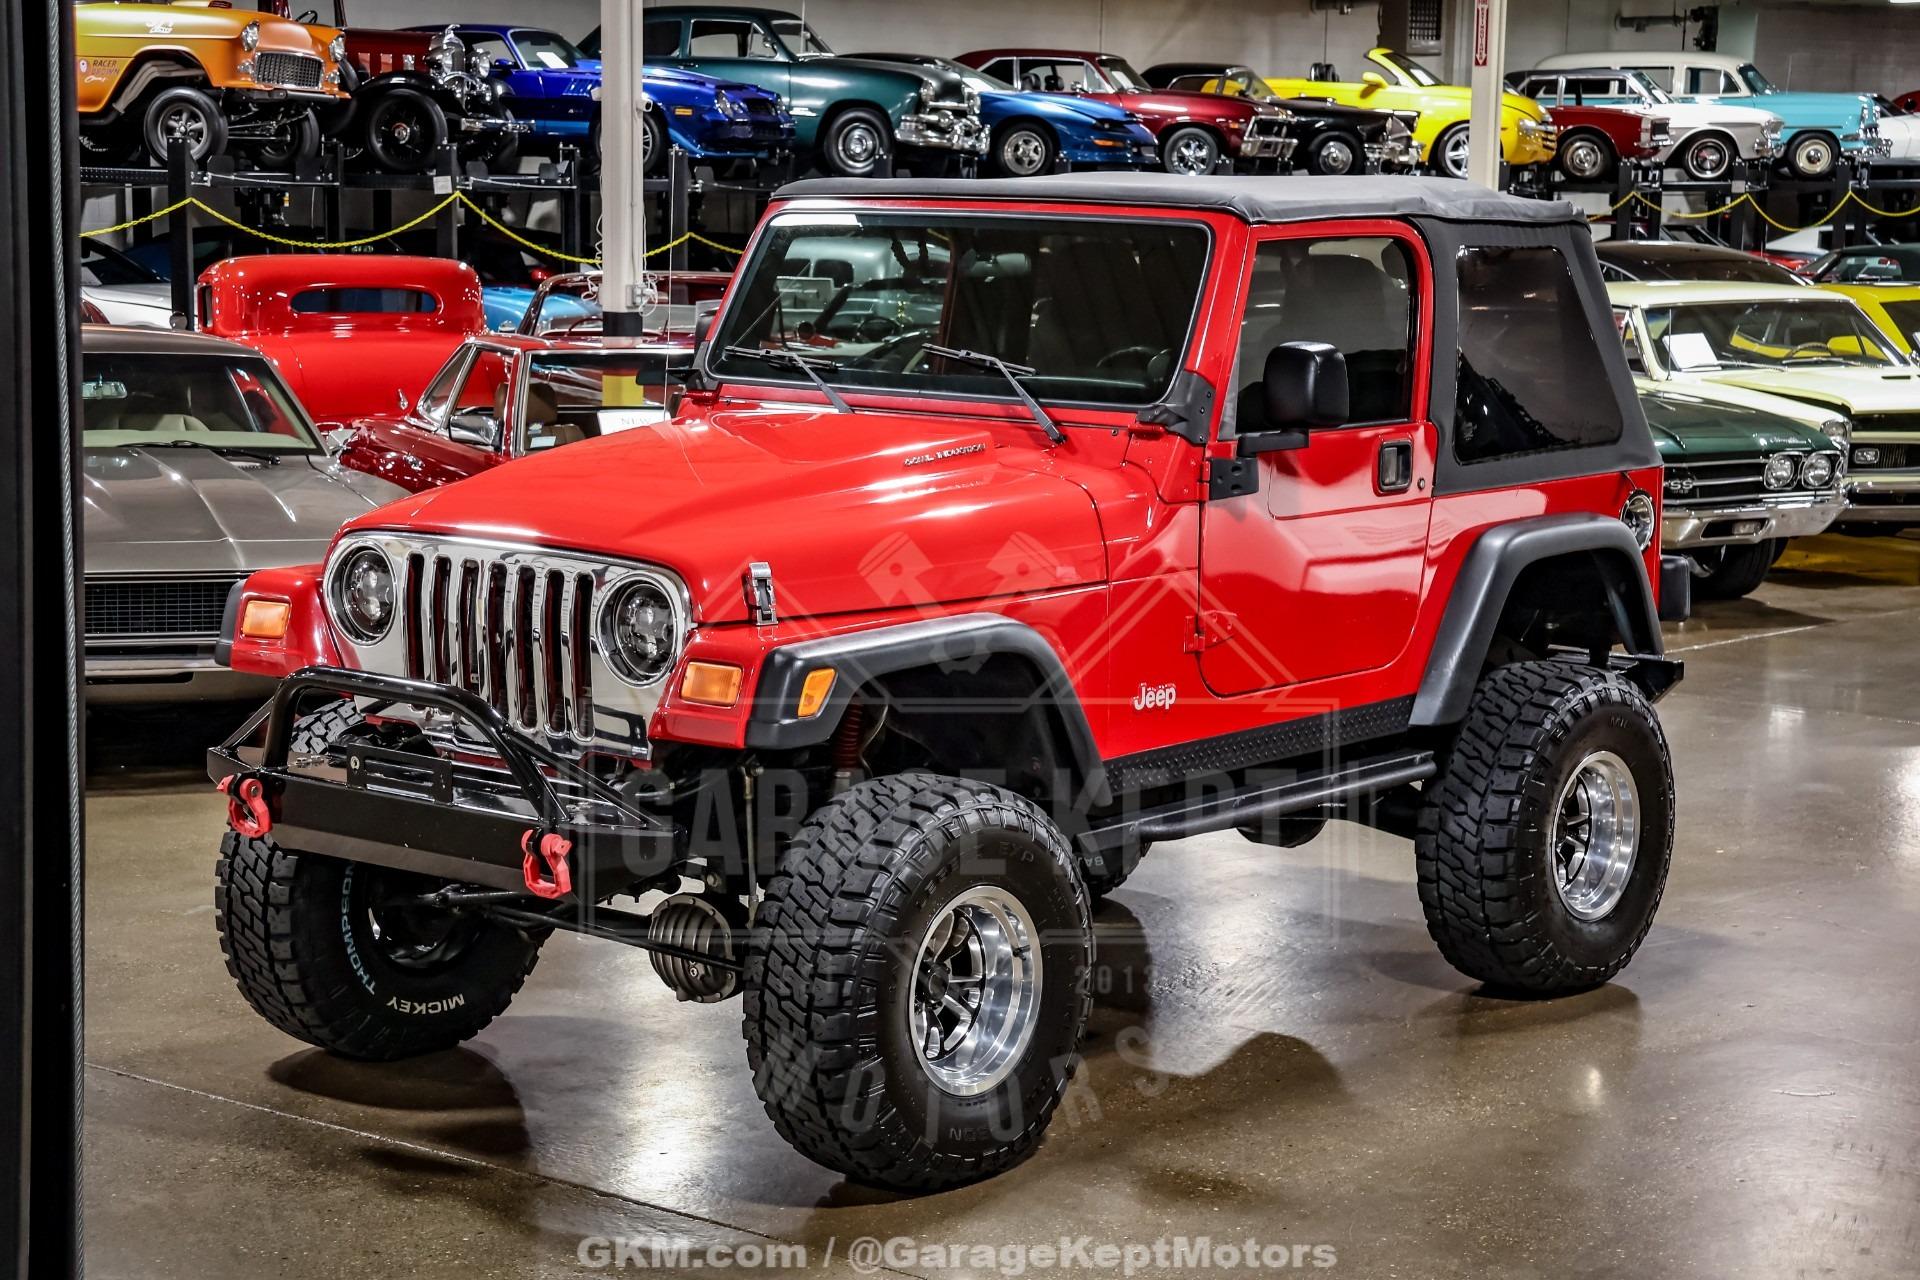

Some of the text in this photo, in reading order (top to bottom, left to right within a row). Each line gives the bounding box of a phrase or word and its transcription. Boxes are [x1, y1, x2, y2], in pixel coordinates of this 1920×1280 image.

[1670, 480, 1693, 490] SS
[1133, 683, 1176, 710] Jeep
[386, 993, 465, 1014] MICKEY
